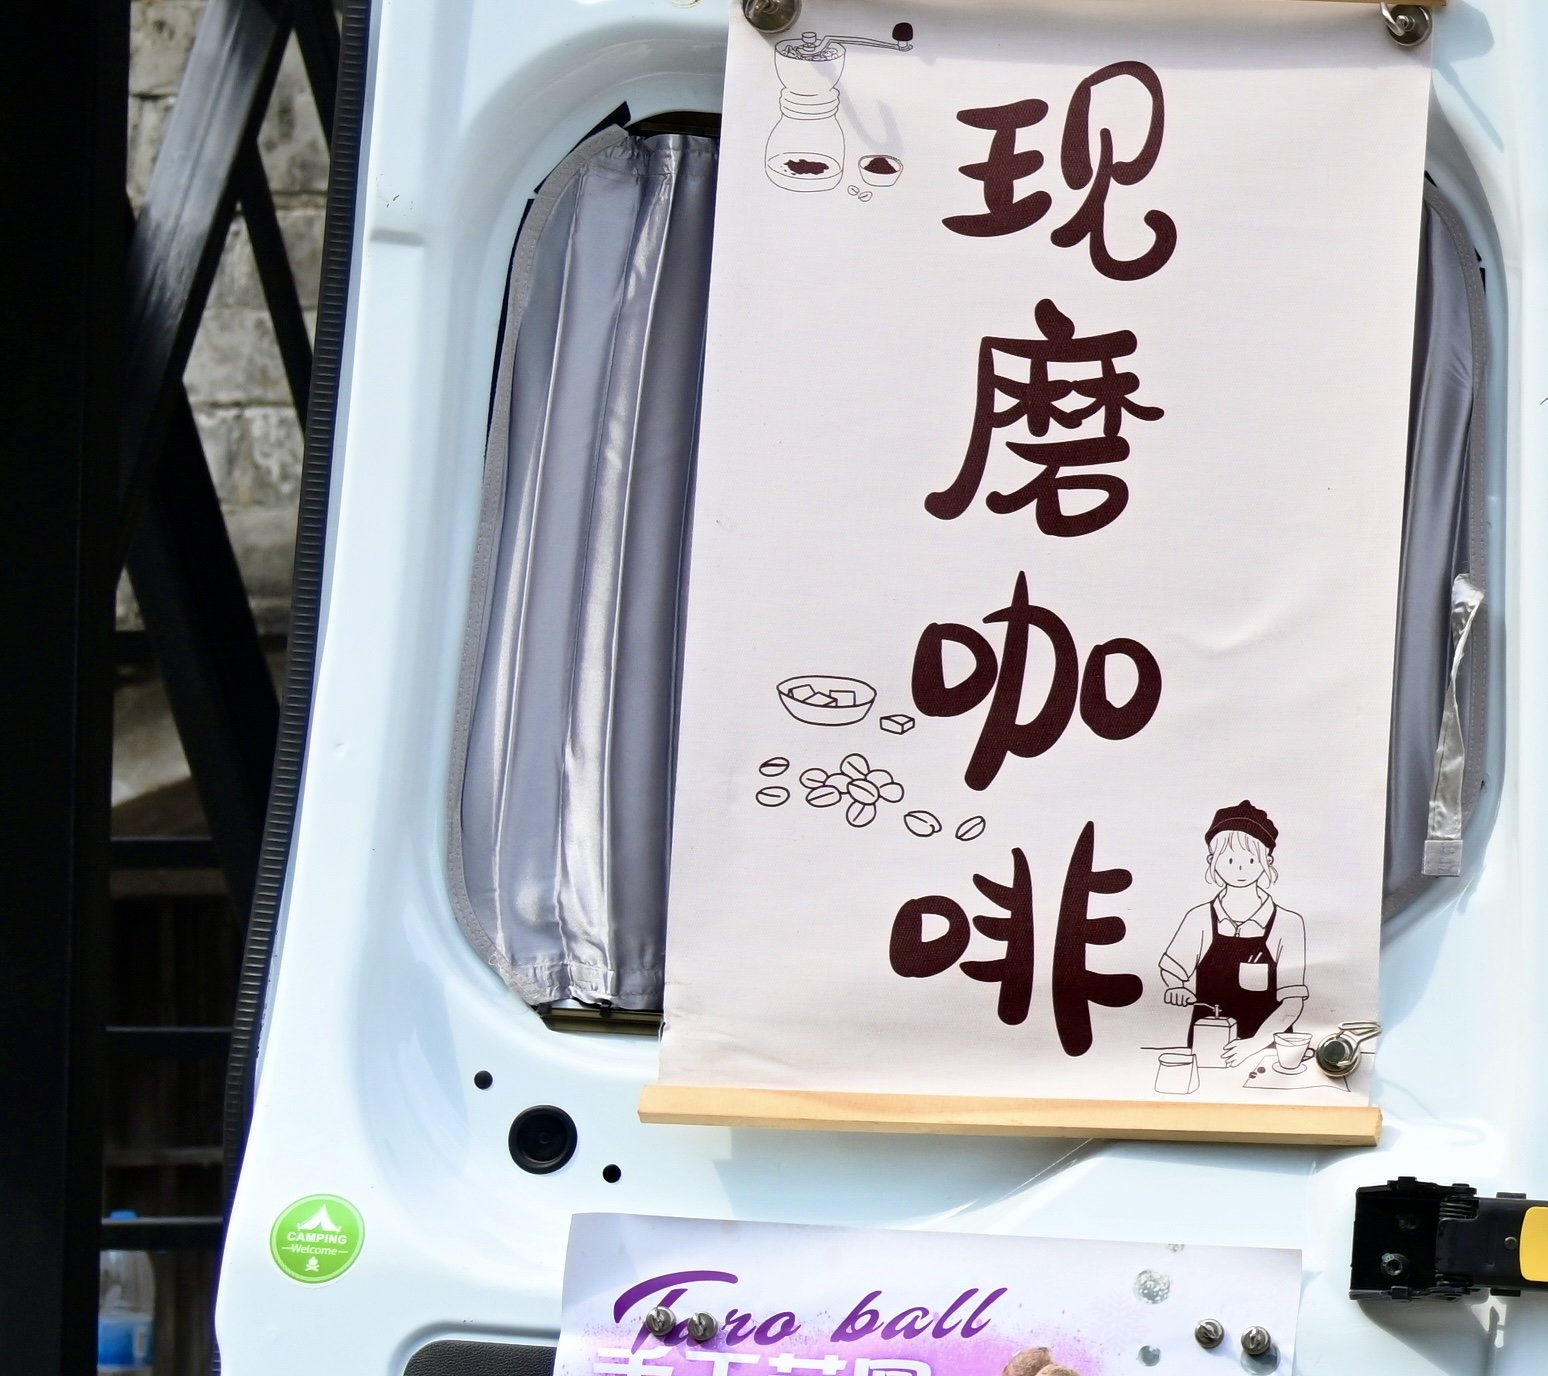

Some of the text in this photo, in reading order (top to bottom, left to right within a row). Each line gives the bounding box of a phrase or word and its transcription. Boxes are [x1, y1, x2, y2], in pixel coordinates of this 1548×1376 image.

[888, 58, 1178, 1057] 现磨咖啡
[287, 1231, 347, 1245] CAMPING
[291, 1244, 338, 1255] Welcome
[830, 1287, 1008, 1344] ball
